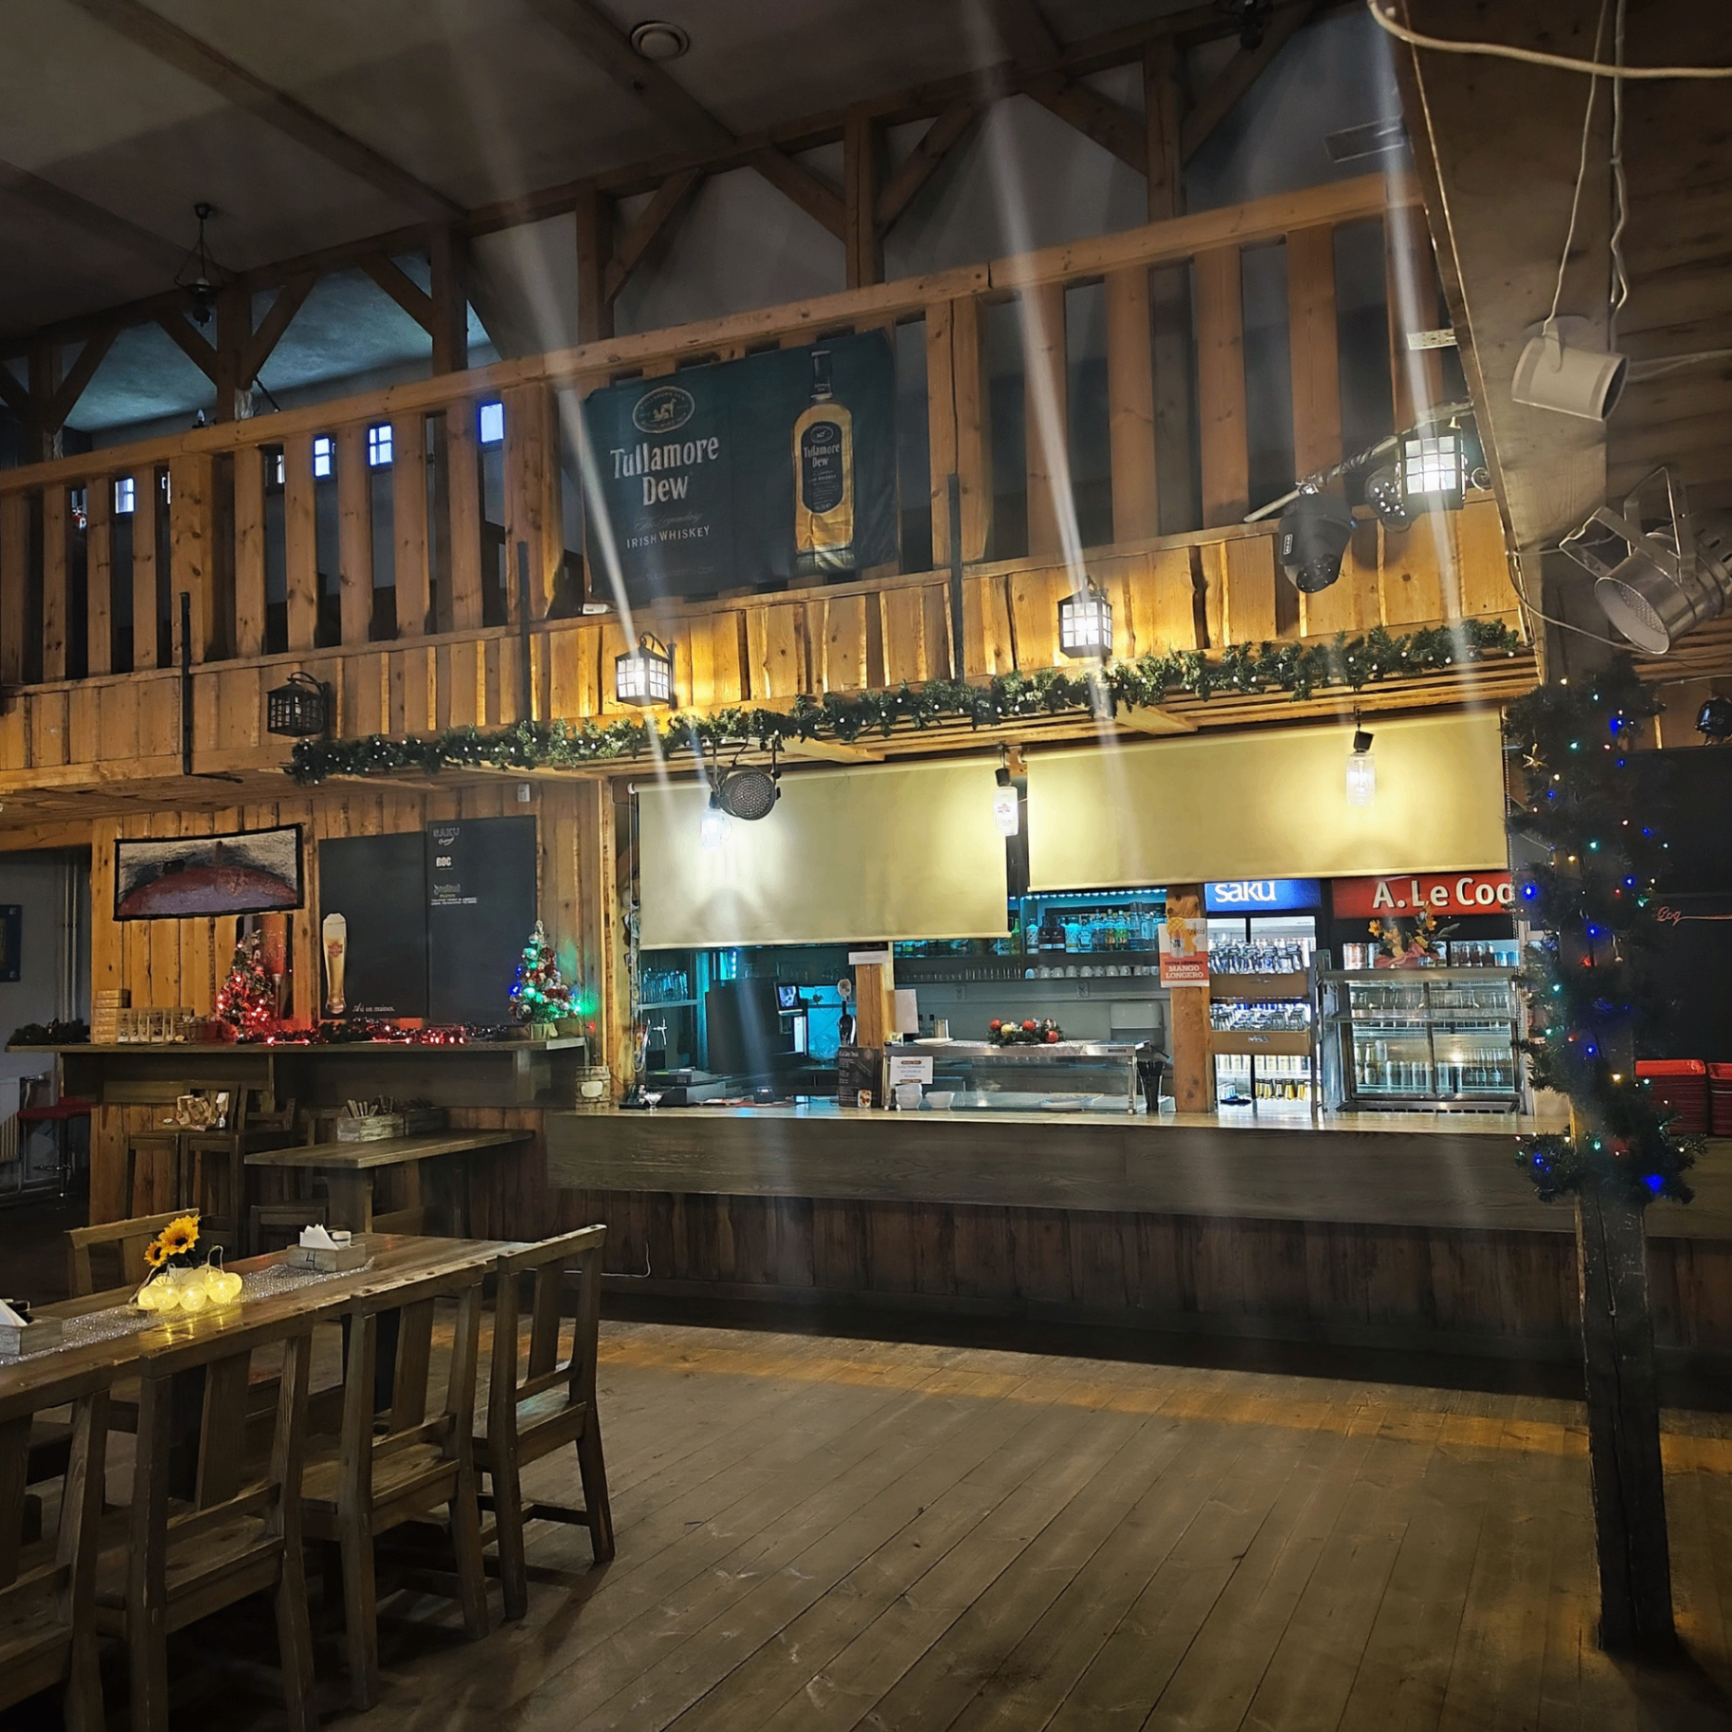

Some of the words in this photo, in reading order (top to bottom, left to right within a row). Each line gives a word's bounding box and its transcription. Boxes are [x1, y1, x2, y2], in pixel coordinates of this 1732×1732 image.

[610, 436, 719, 478] Tullamore
[643, 475, 688, 506] Dew
[626, 533, 657, 549] IRISH
[659, 524, 710, 542] WHISKEY
[1214, 881, 1277, 903] saku
[1168, 964, 1200, 972] MANGO
[306, 1250, 316, 1269] 4
